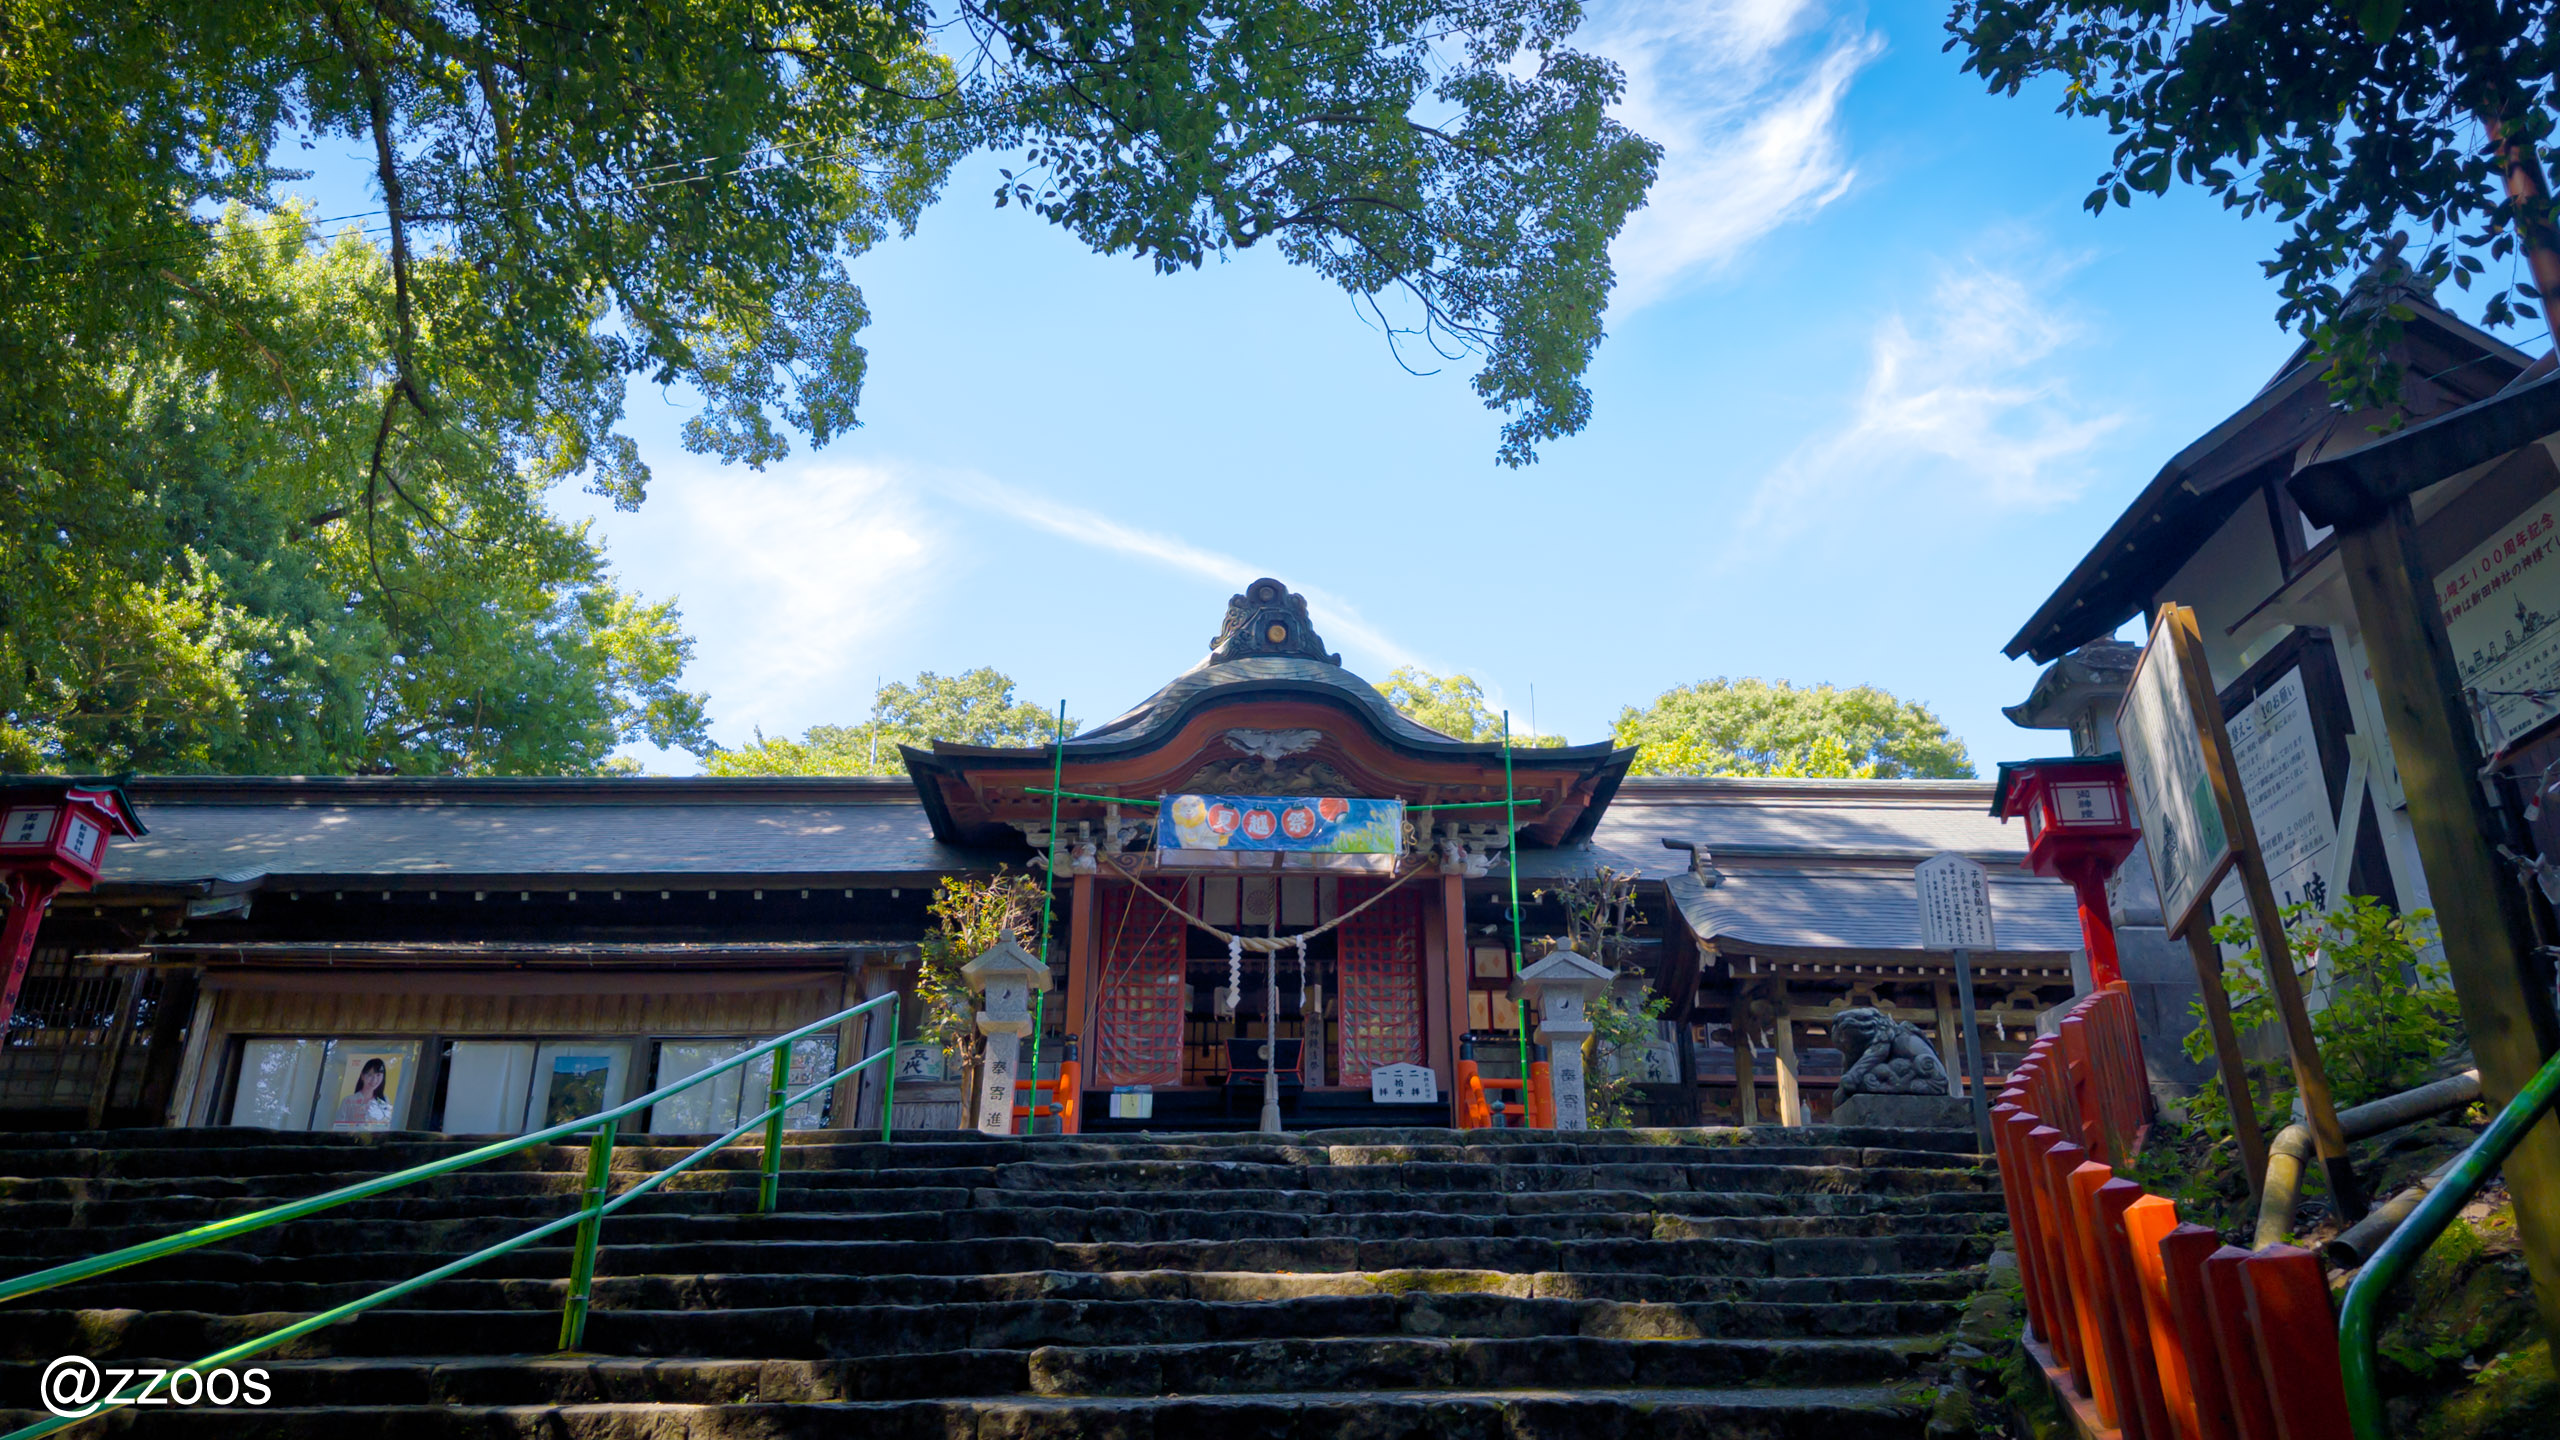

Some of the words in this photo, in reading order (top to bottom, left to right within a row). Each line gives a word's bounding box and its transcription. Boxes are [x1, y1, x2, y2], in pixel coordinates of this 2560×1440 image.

[1213, 810, 1308, 835] 夏越祭
[986, 1060, 1007, 1128] 奉寄進
